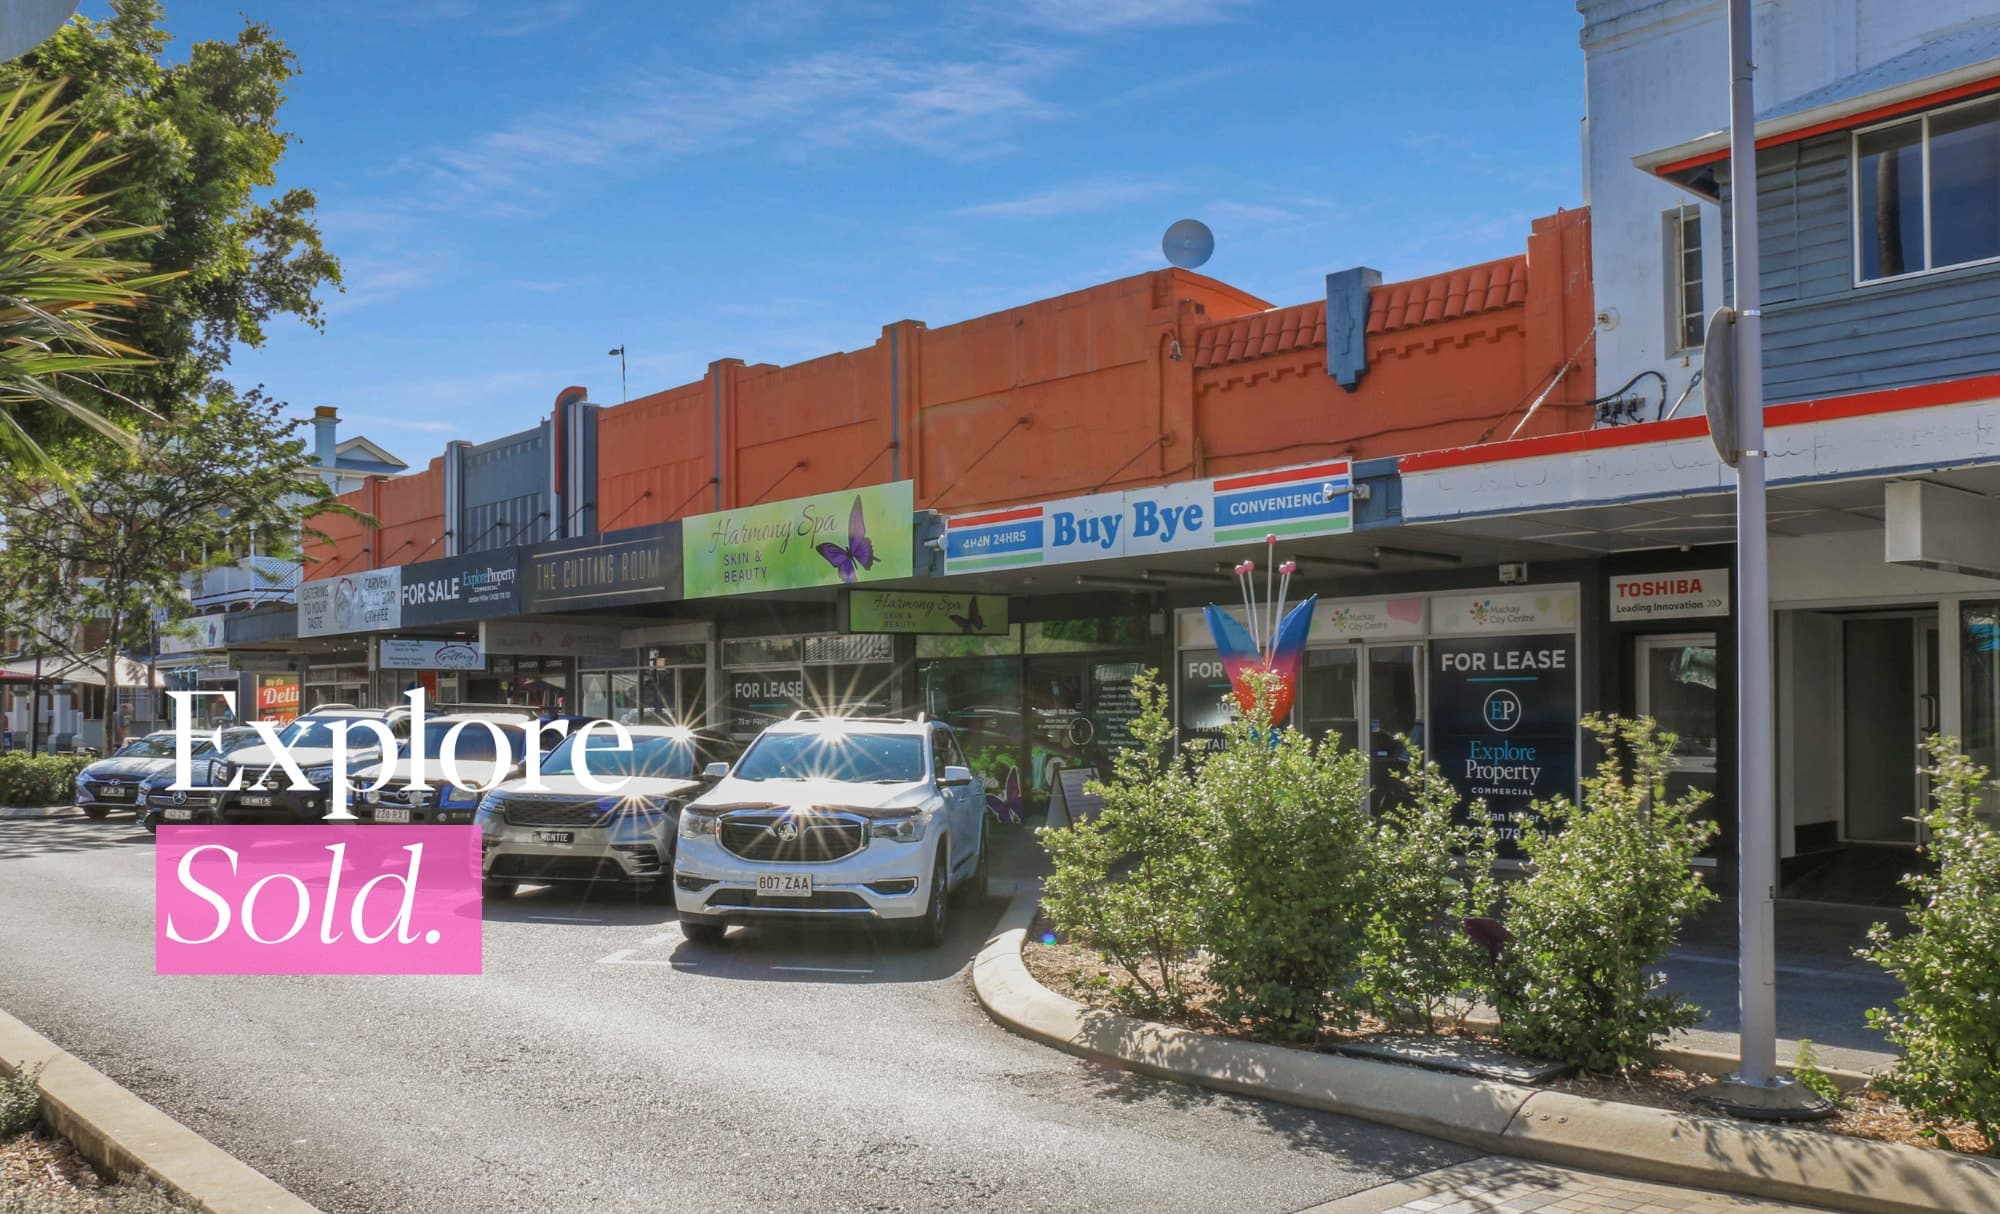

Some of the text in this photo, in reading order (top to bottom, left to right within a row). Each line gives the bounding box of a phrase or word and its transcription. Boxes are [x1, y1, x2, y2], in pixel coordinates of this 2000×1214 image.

[709, 504, 838, 554] Harmony Spa
[1052, 501, 1203, 549] Buy Bye
[993, 530, 1026, 545] 24HRS
[723, 552, 762, 566] SKIN &
[537, 548, 659, 592] THE CUTTING ROOM
[724, 567, 768, 583] BEAUTY
[303, 585, 328, 600] CATERING
[401, 582, 426, 606] FOR
[428, 577, 460, 602] SALE
[1616, 578, 1703, 598] TOSHIBA
[872, 593, 960, 616] Harmony Spa
[1490, 604, 1521, 614] Mackay
[1616, 600, 1703, 613] Leading Innovation
[364, 608, 389, 623] COFFEE
[1489, 614, 1536, 624] City Centre
[1364, 621, 1388, 630] Centre
[1441, 650, 1566, 672] FOR LEASE
[1189, 662, 1223, 679] FOR
[735, 681, 802, 699] FOR LEASE
[1490, 700, 1515, 720] EP
[1469, 739, 1537, 766] Explore
[1465, 759, 1541, 786] Property
[1471, 786, 1535, 796] COMMERCIAL
